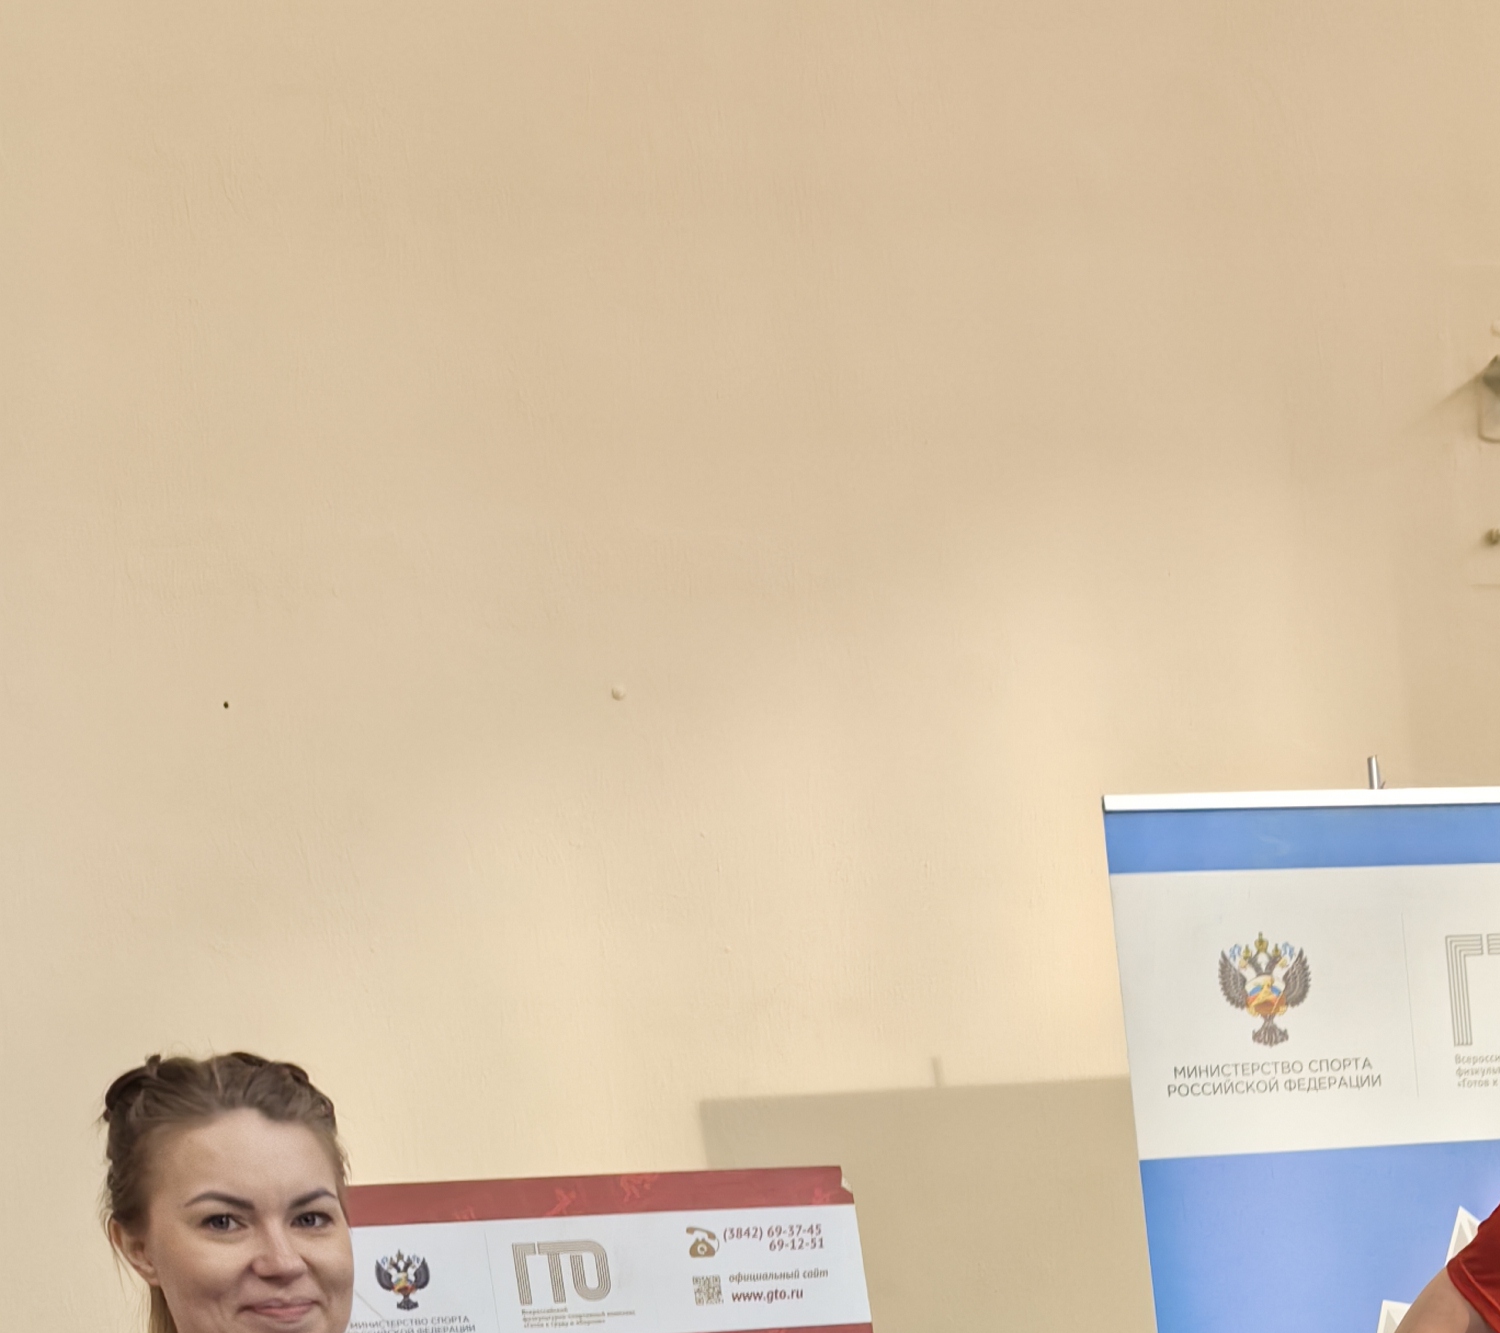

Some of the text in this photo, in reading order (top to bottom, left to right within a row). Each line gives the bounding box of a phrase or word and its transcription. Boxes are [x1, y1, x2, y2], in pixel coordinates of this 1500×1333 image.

[1173, 1057, 1373, 1080] МИНИСТЕРСТВО СПОРТА
[1167, 1074, 1382, 1098] РОССИЙСКОЙ ФЕДЕРАЦИИ
[723, 1223, 822, 1243] (3842) 69-37-45
[768, 1236, 825, 1252] 69-12-51
[512, 1238, 612, 1306] ГТО
[728, 1267, 829, 1285] официальный сайт
[731, 1288, 804, 1304] www.gto.ru
